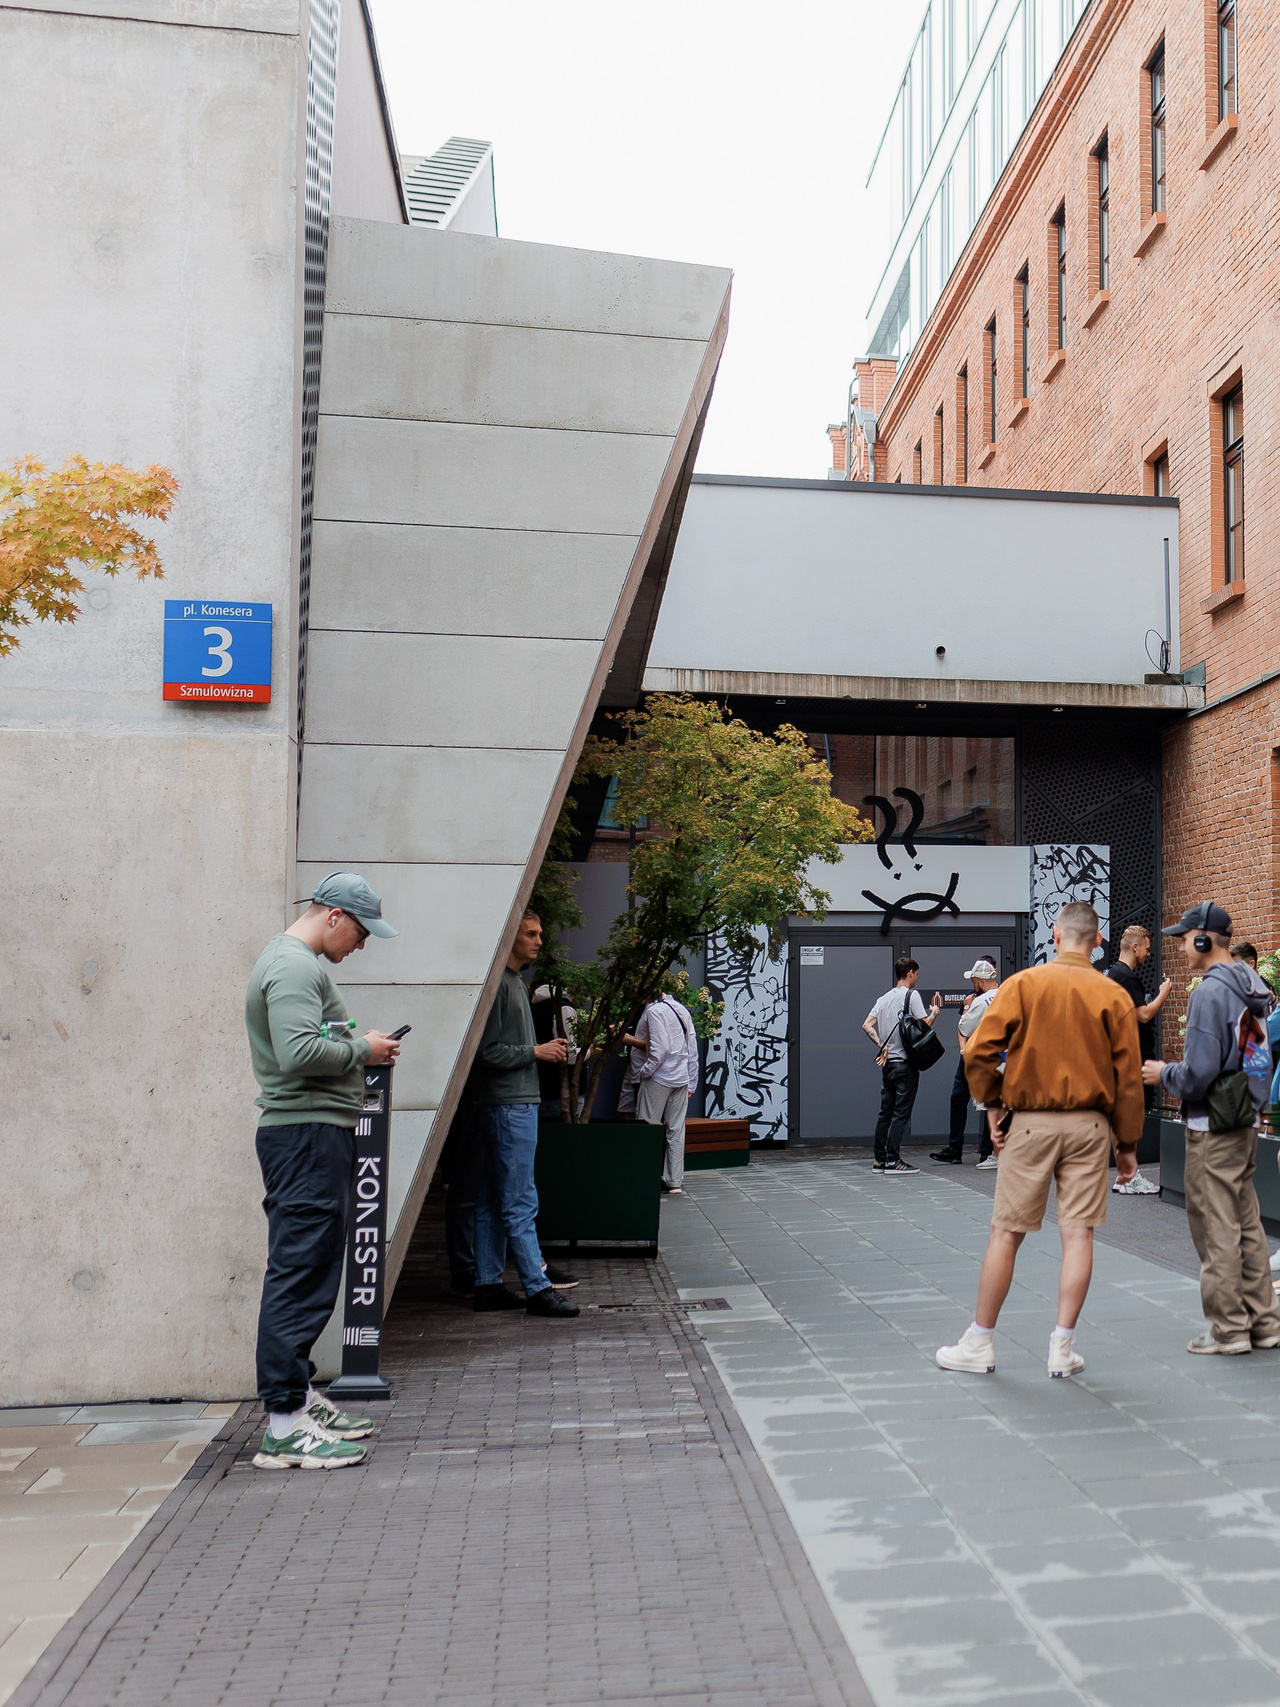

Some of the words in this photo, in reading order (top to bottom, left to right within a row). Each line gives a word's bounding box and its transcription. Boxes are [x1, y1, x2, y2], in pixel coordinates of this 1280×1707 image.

[183, 603, 197, 618] pl.
[201, 604, 253, 617] Konesera
[201, 626, 233, 677] 3
[180, 685, 254, 698] Szmulowizna
[352, 1156, 381, 1306] KONESER
